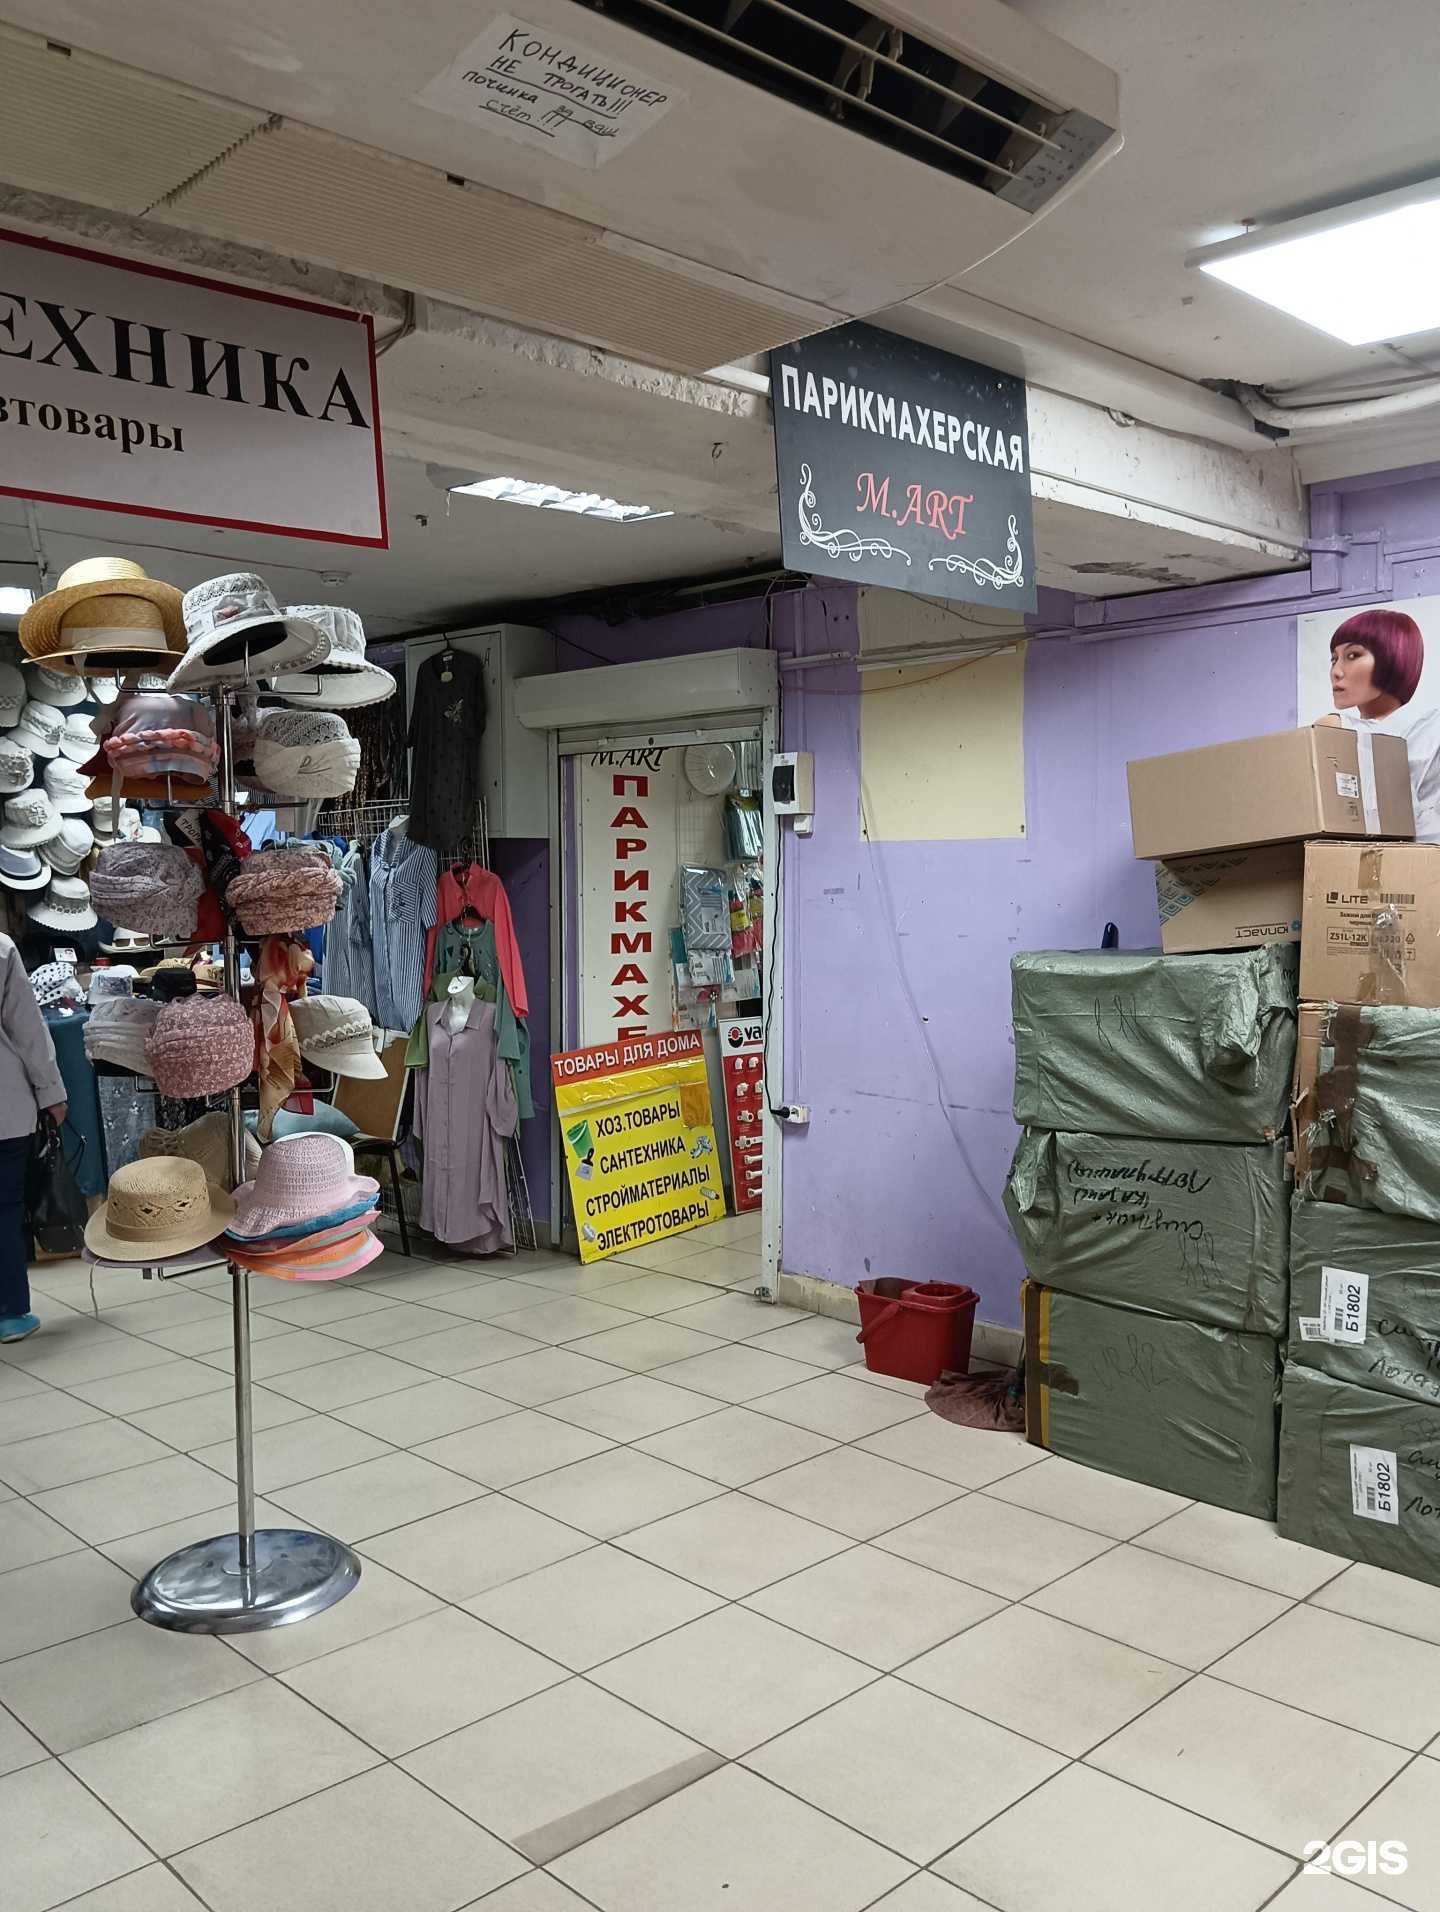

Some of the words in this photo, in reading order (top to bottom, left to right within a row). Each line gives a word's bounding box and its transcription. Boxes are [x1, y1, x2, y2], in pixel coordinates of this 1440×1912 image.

[489, 55, 524, 74] НЕ
[781, 363, 1024, 474] ПАРИКМАХЕРСКАЯ
[856, 472, 974, 540] M.ART
[554, 1053, 620, 1078] ТОВАРЫ
[622, 1042, 654, 1066] ДЛЯ
[657, 1033, 701, 1059] ДОМА
[595, 1101, 681, 1138] ХОЗ.ТОВАРЫ
[600, 1135, 686, 1174] САНТЕХНИКА
[586, 1164, 710, 1217] СТРОЙМАТЕРИАЛЫ
[596, 1201, 710, 1251] ЭЛЕКТРОТОВАРЫ
